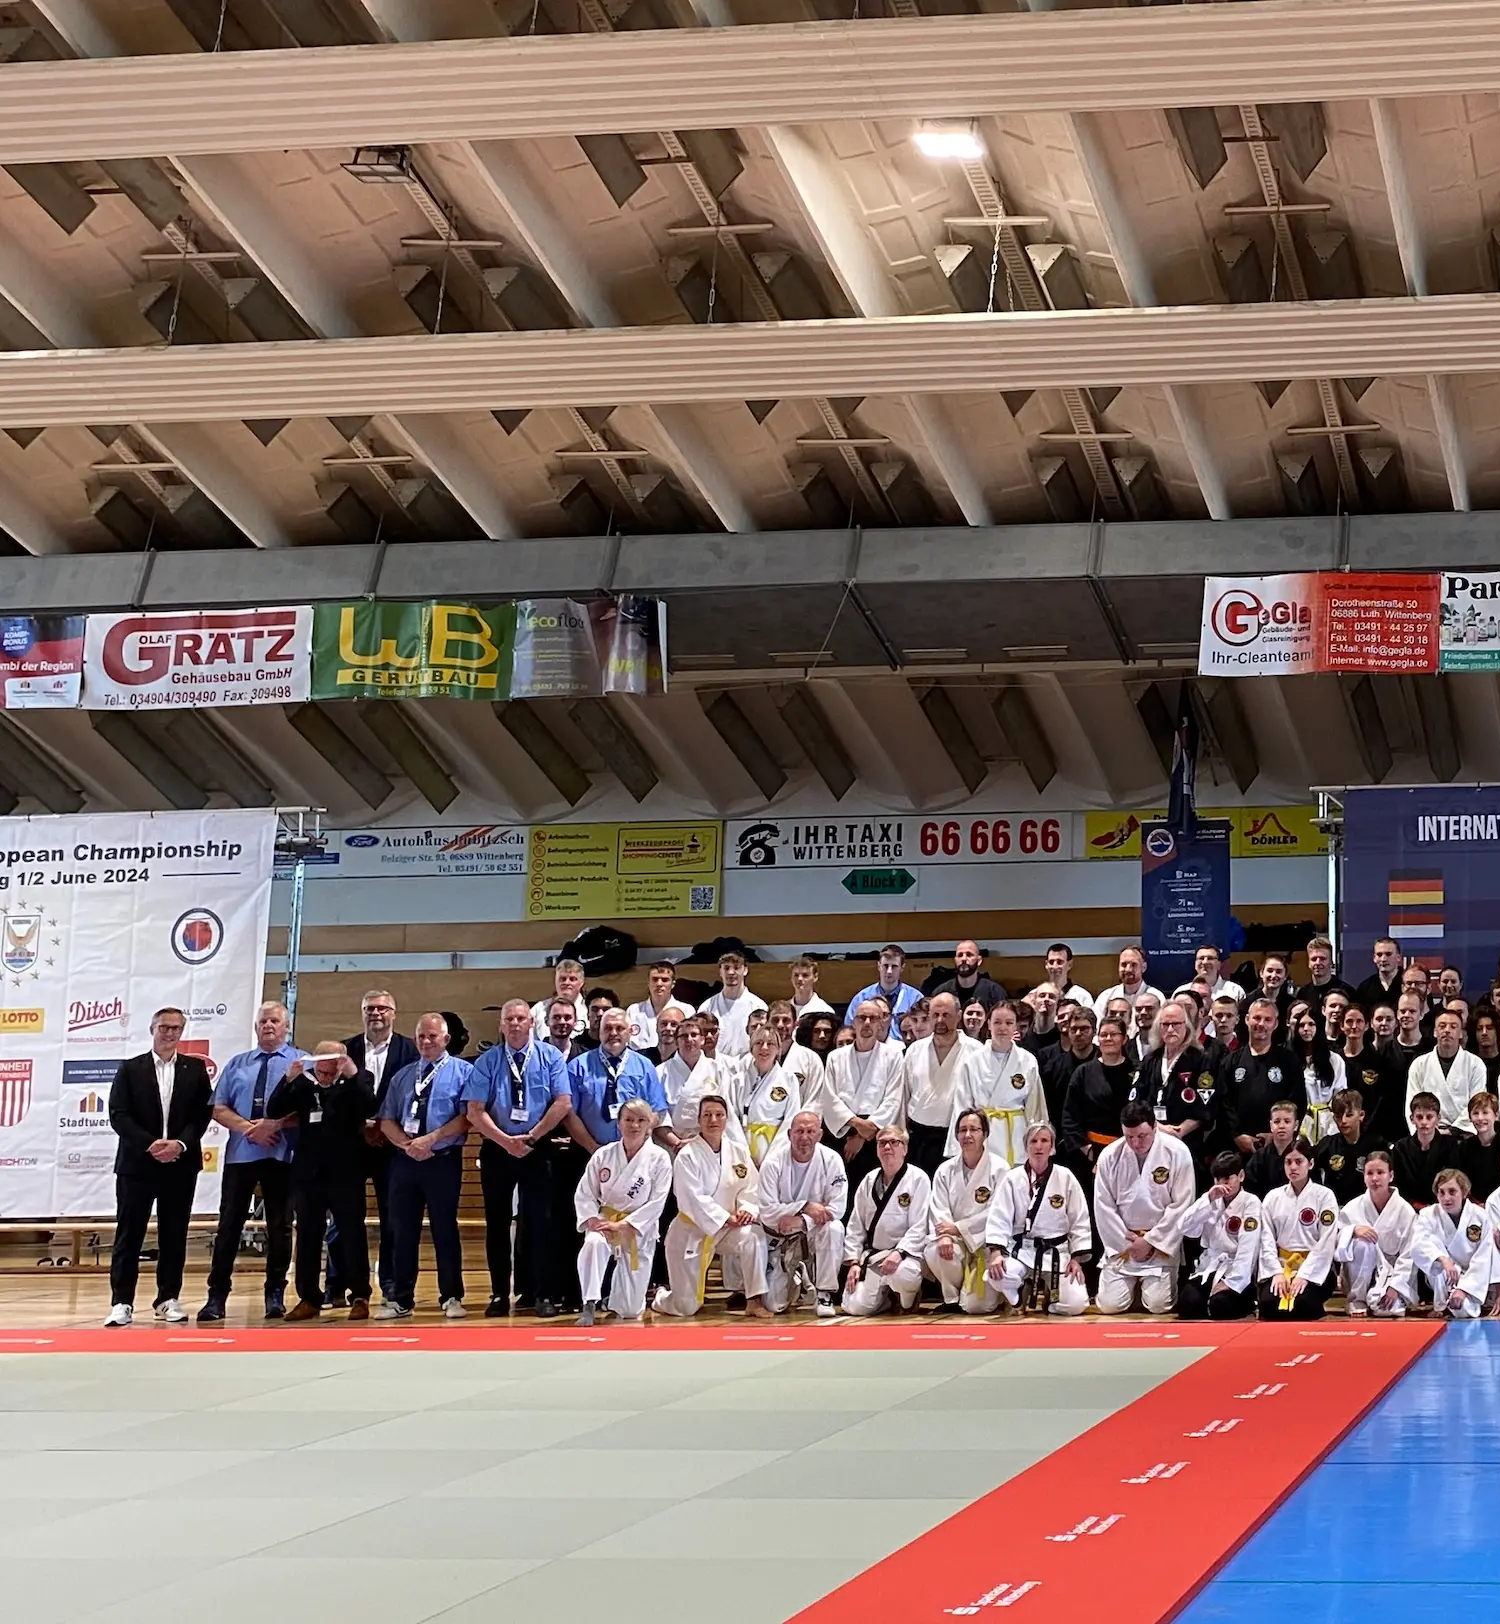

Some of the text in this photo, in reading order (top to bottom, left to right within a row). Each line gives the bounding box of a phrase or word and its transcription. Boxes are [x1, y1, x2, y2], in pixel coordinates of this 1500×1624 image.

[1331, 599, 1418, 608] Dorotheenstraße 50
[1212, 590, 1312, 646] GeGla
[1385, 610, 1432, 621] Wittenberg
[1262, 624, 1311, 634] Gebäude- und
[1355, 622, 1380, 631] 03491
[1403, 624, 1414, 632] 25
[1416, 624, 1428, 632] 97
[139, 634, 172, 645] OLAF
[1262, 634, 1311, 644] Glasreinigung
[1355, 634, 1380, 642] 03491
[1389, 635, 1400, 643] 44
[1403, 636, 1414, 644] 30
[1418, 636, 1428, 644] 18
[103, 611, 297, 686] GRÄTZ
[1363, 645, 1426, 656] info@gegla.de
[1212, 649, 1315, 664] Ihr-Cleanteam!
[21, 661, 39, 671] der
[40, 661, 74, 673] Region
[1367, 658, 1428, 669] www.gegla.de
[171, 667, 293, 684] Gehäusebau GmbH
[104, 686, 291, 705] Tel.: 034904/309490 Fax: 309498
[428, 686, 451, 694] 59 51
[351, 833, 448, 848] Ford Autohaus
[793, 818, 1060, 856] IHR TAXI 66 66 66
[1251, 832, 1298, 846] DÖHLER
[73, 840, 242, 862] Championship
[476, 852, 524, 862] Wittenberg
[793, 843, 903, 860] WITTENBERG
[509, 863, 523, 871] 551
[17, 868, 149, 887] 1/2 June 2024
[851, 874, 896, 888] A Block
[2, 1011, 39, 1023] LOTTO
[68, 997, 122, 1025] Ditsch
